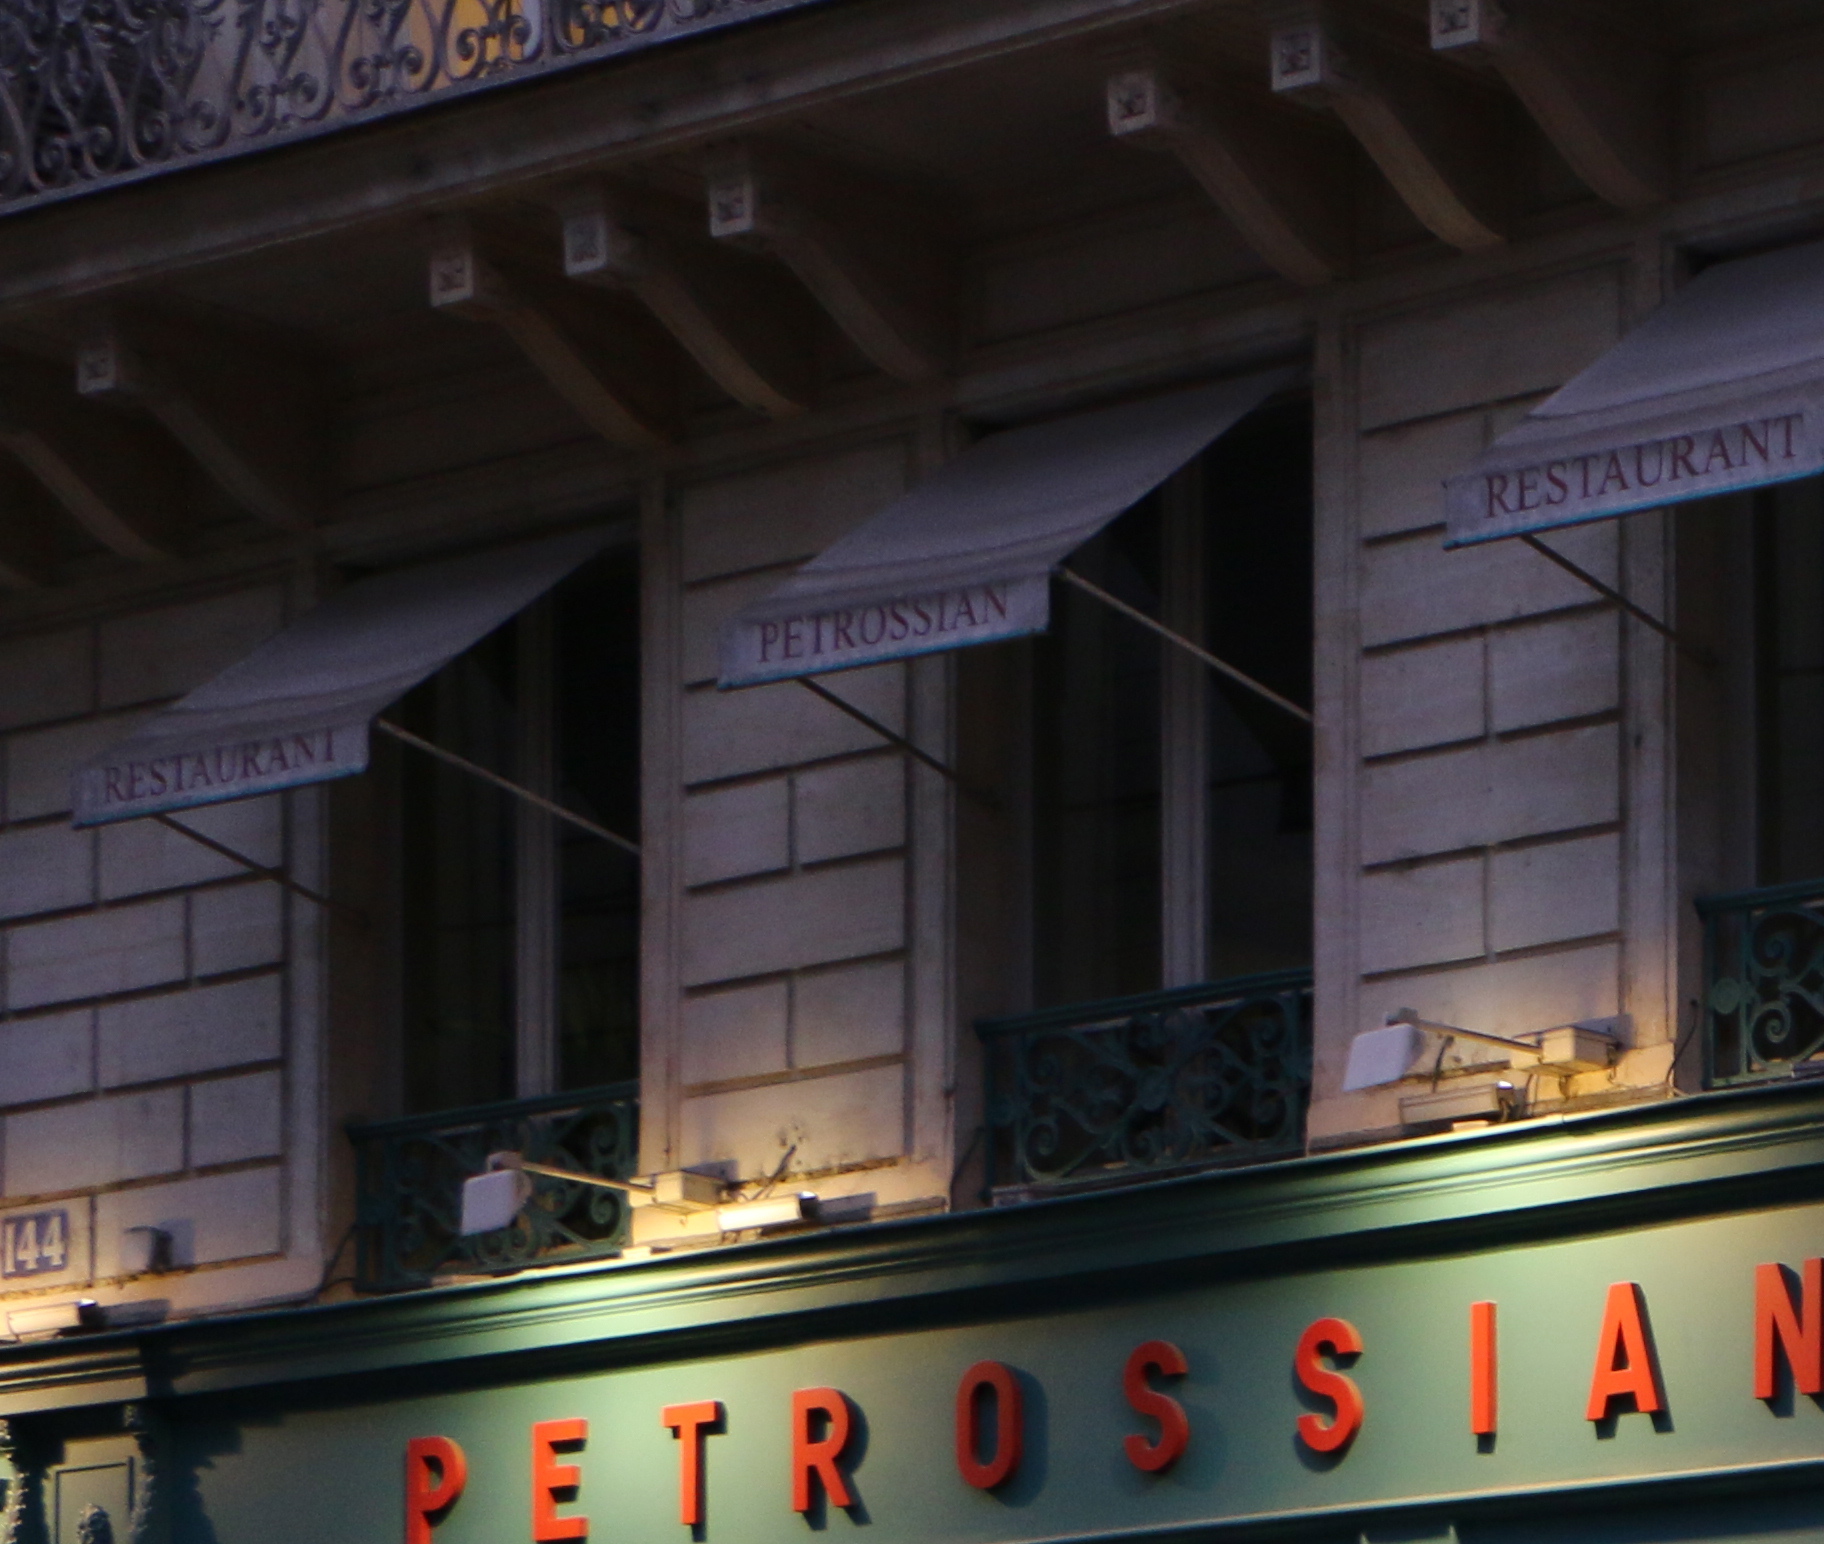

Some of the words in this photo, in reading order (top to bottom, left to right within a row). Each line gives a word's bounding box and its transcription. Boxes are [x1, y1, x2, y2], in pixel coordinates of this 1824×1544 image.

[1484, 413, 1803, 519] RESTAURANT
[758, 584, 1009, 663] PETROSSIAN
[103, 727, 335, 803] RESTAURANT
[4, 1215, 66, 1274] 144
